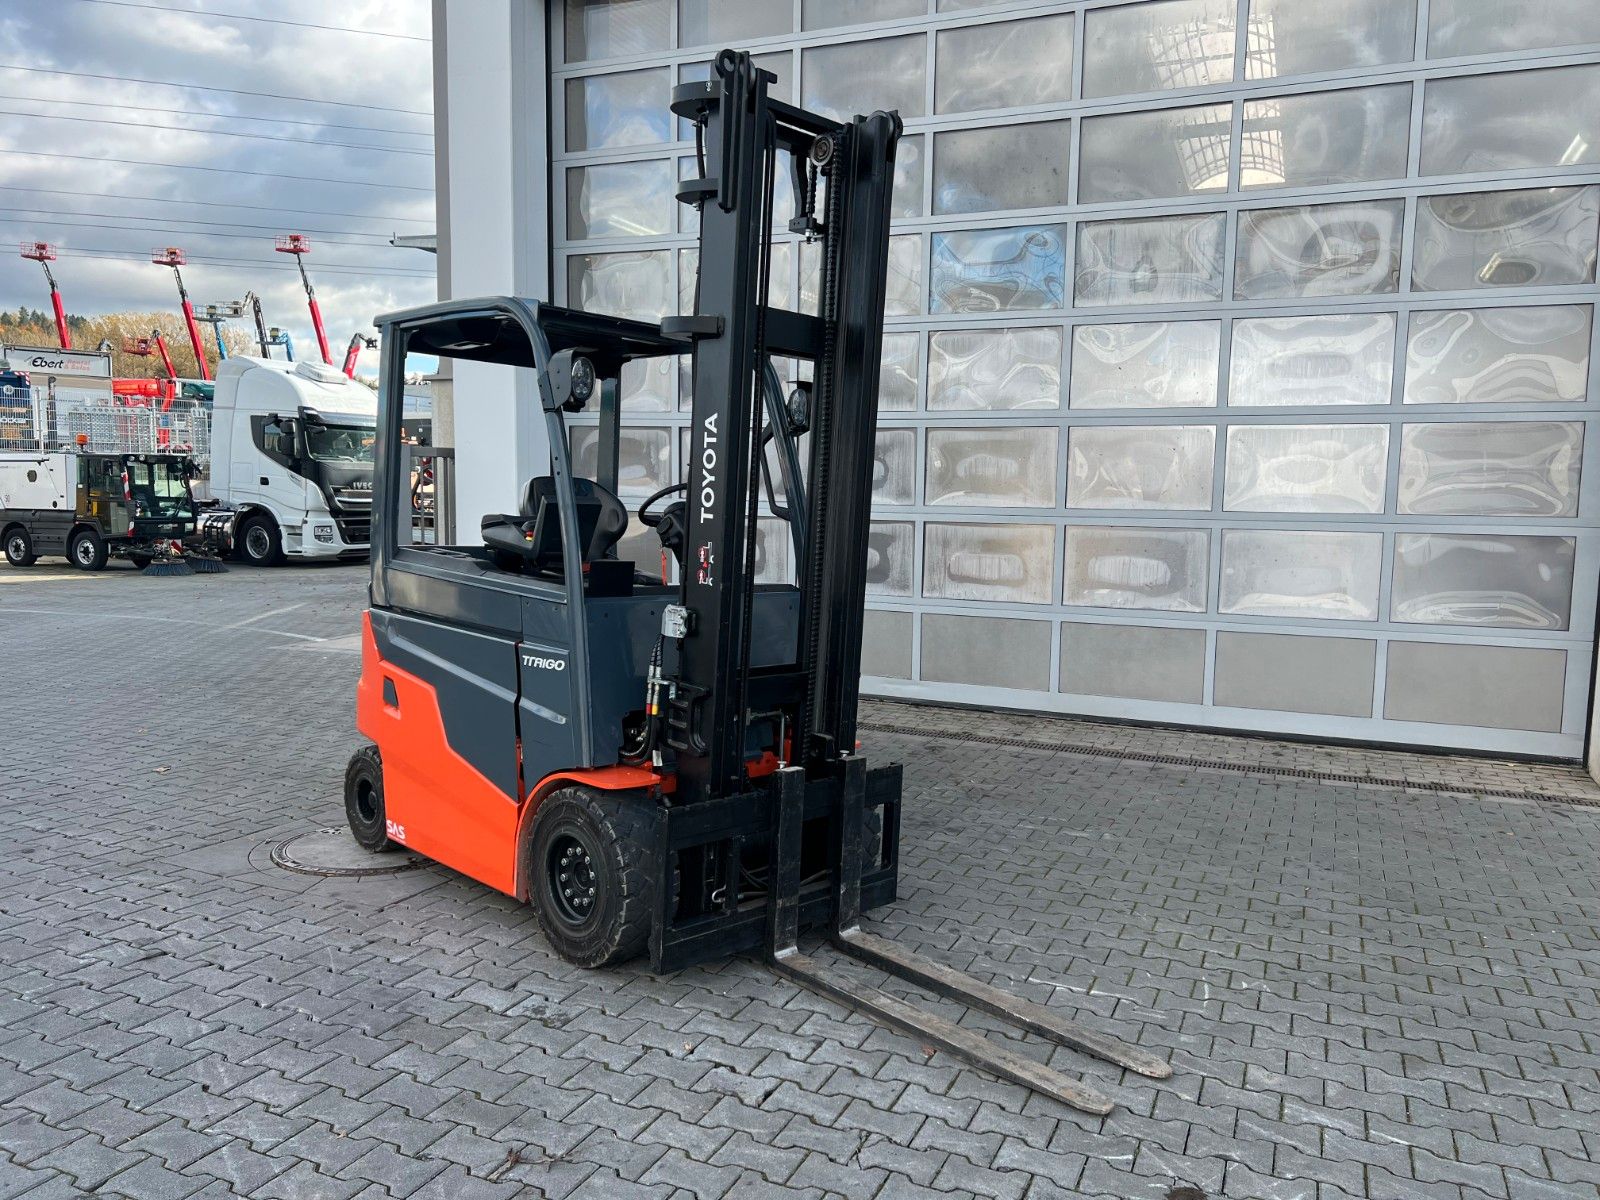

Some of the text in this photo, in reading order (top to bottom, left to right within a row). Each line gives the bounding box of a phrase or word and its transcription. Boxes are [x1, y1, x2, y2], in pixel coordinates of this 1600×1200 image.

[31, 356, 64, 369] Ebert
[700, 412, 719, 524] TOYOTA
[353, 481, 374, 490] IVEC
[386, 819, 406, 840] SAS
